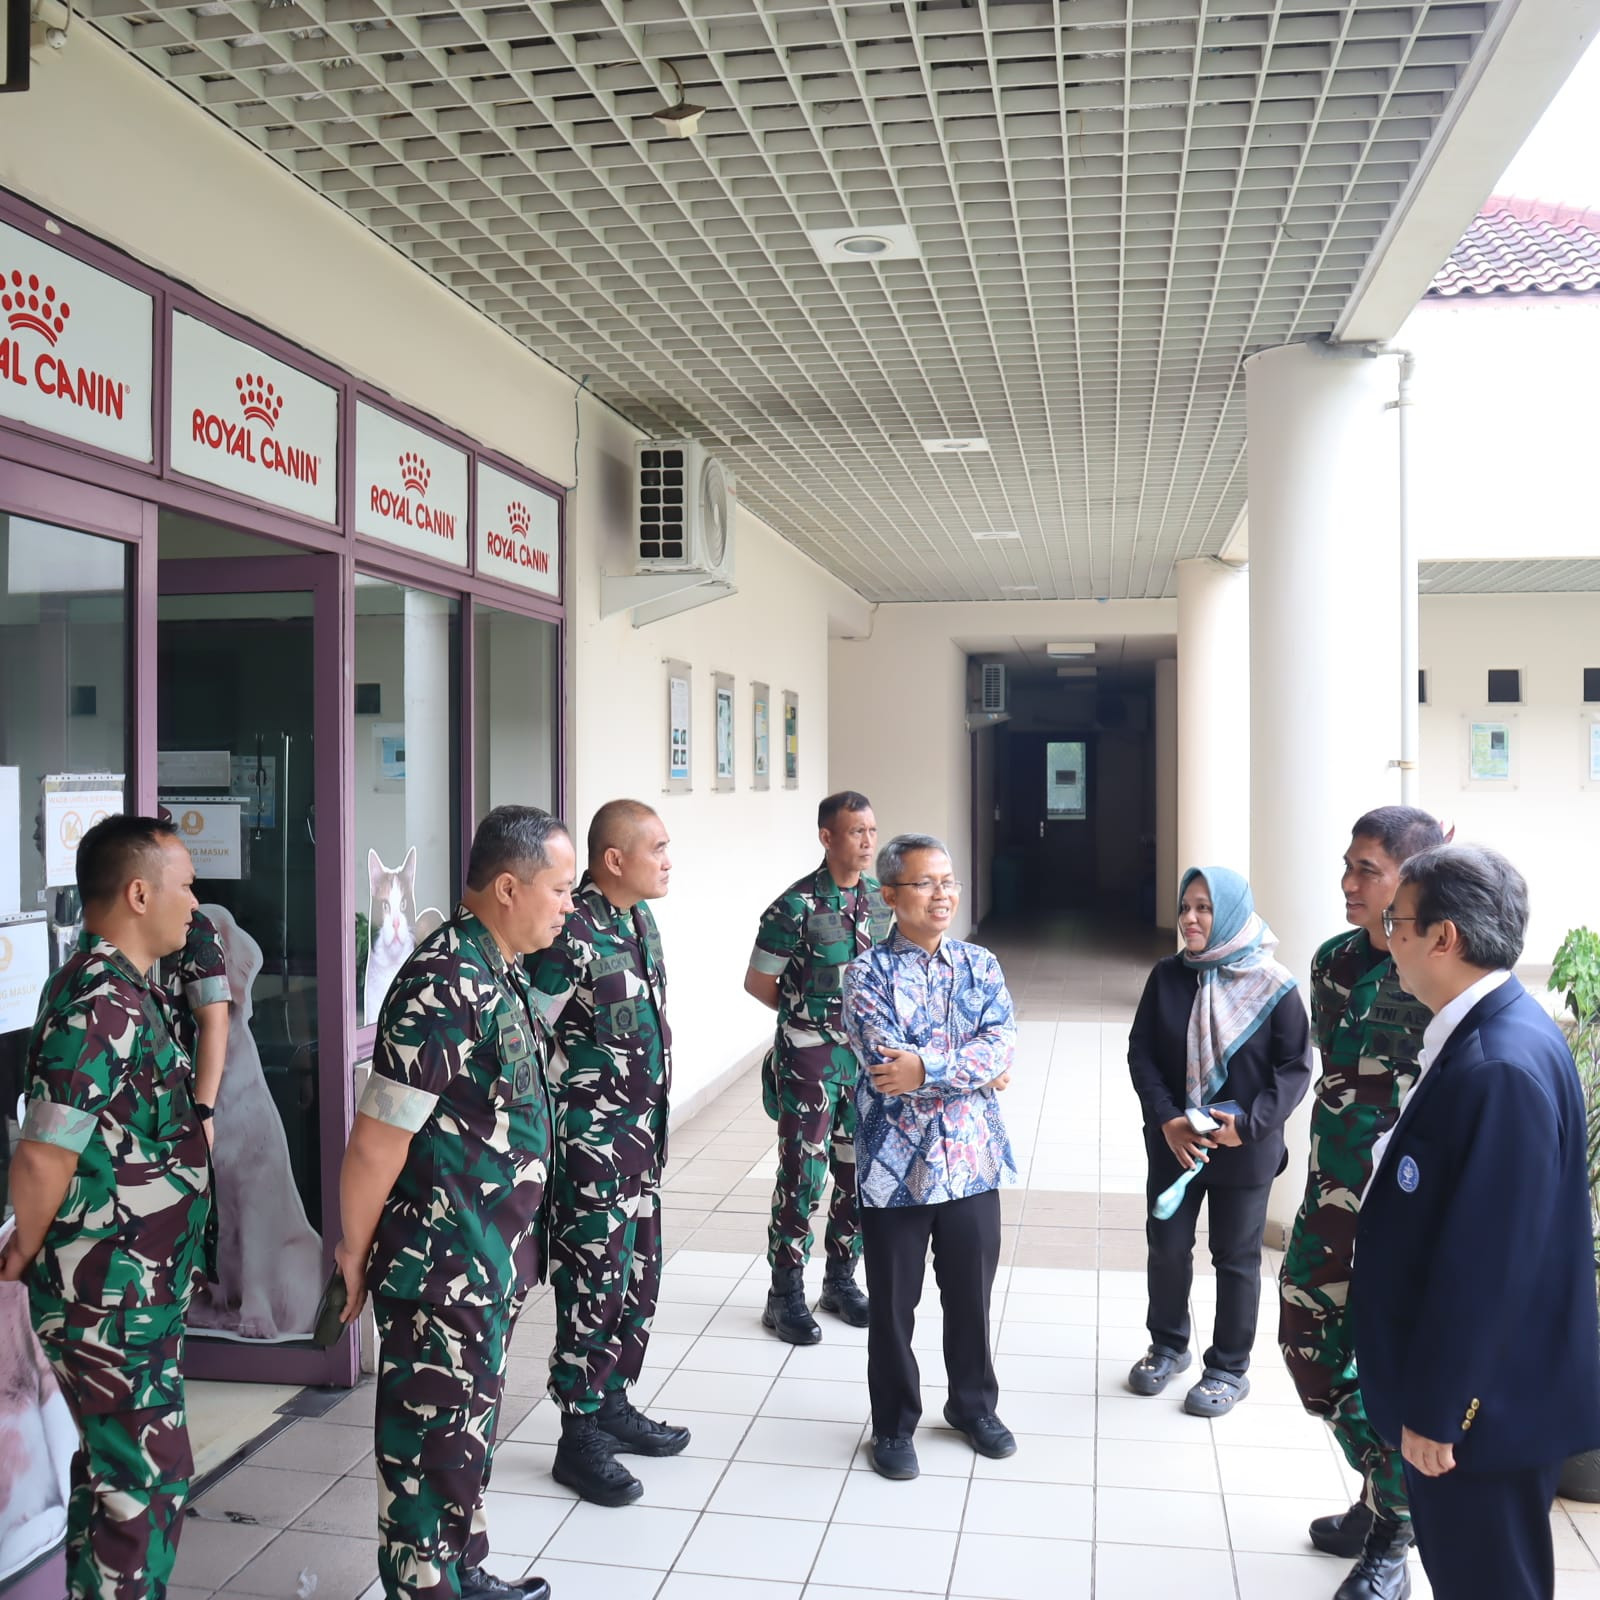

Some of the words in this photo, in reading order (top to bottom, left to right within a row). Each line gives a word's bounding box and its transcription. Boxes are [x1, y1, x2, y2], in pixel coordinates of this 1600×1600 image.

[34, 353, 123, 420] CANIN
[192, 408, 256, 463] ROYAL
[260, 437, 317, 486] CANIN
[370, 484, 412, 526] ROYAL
[415, 503, 455, 540] CANIN
[487, 531, 518, 564] ROYAL
[519, 544, 548, 574] CANIN
[200, 848, 229, 856] MASUK
[596, 955, 628, 974] JACKY
[1375, 1007, 1397, 1021] TNI
